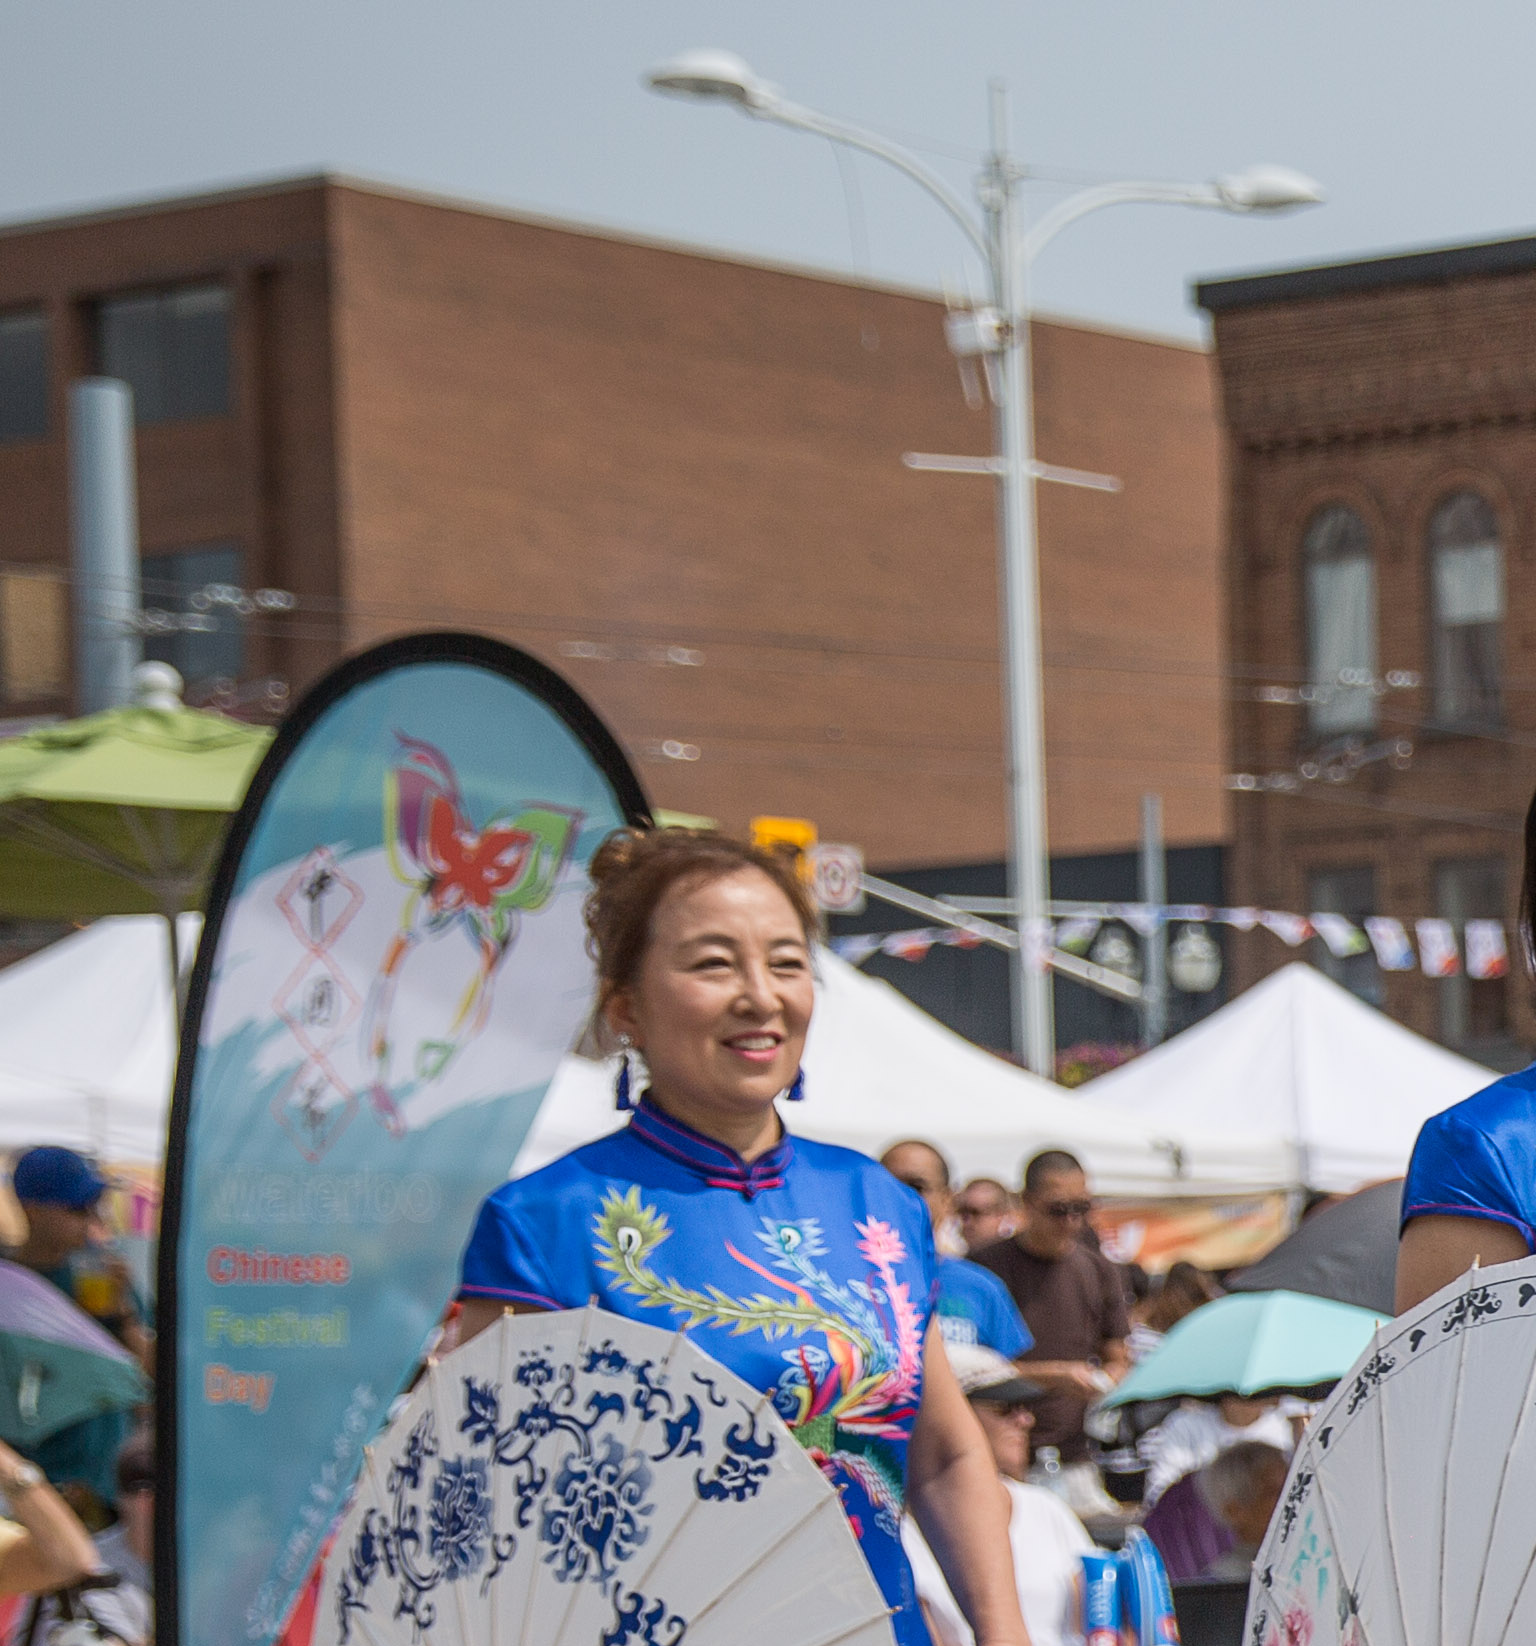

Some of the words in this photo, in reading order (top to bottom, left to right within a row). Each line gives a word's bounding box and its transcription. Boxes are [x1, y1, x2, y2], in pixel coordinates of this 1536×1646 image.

[212, 1166, 439, 1224] Waterloo
[207, 1247, 350, 1286] Chinese
[205, 1307, 348, 1348] Festival
[205, 1364, 275, 1414] Day
